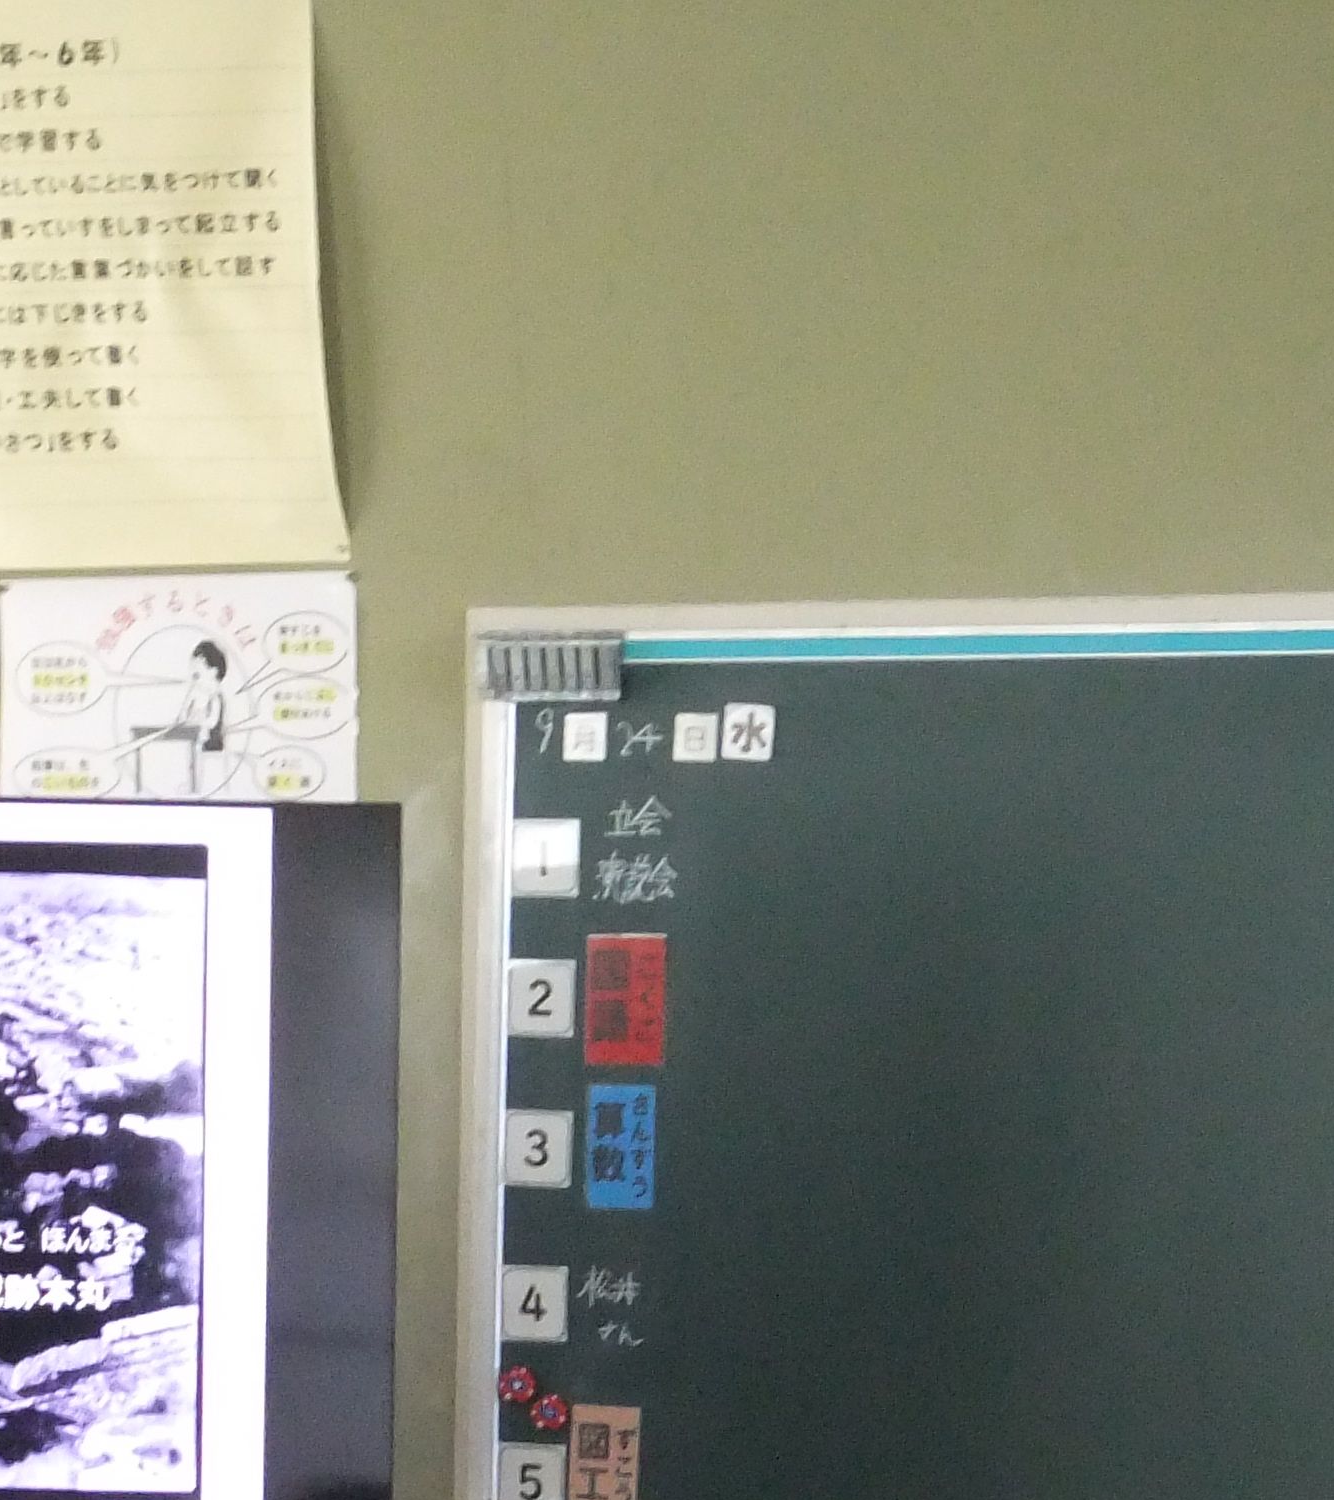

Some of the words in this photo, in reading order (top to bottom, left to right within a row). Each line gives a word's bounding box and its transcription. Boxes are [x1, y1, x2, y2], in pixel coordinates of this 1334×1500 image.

[533, 706, 555, 755] 9
[730, 710, 767, 754] 水
[527, 977, 554, 1018] 2
[524, 1128, 550, 1168] 3
[521, 1283, 548, 1323] 4
